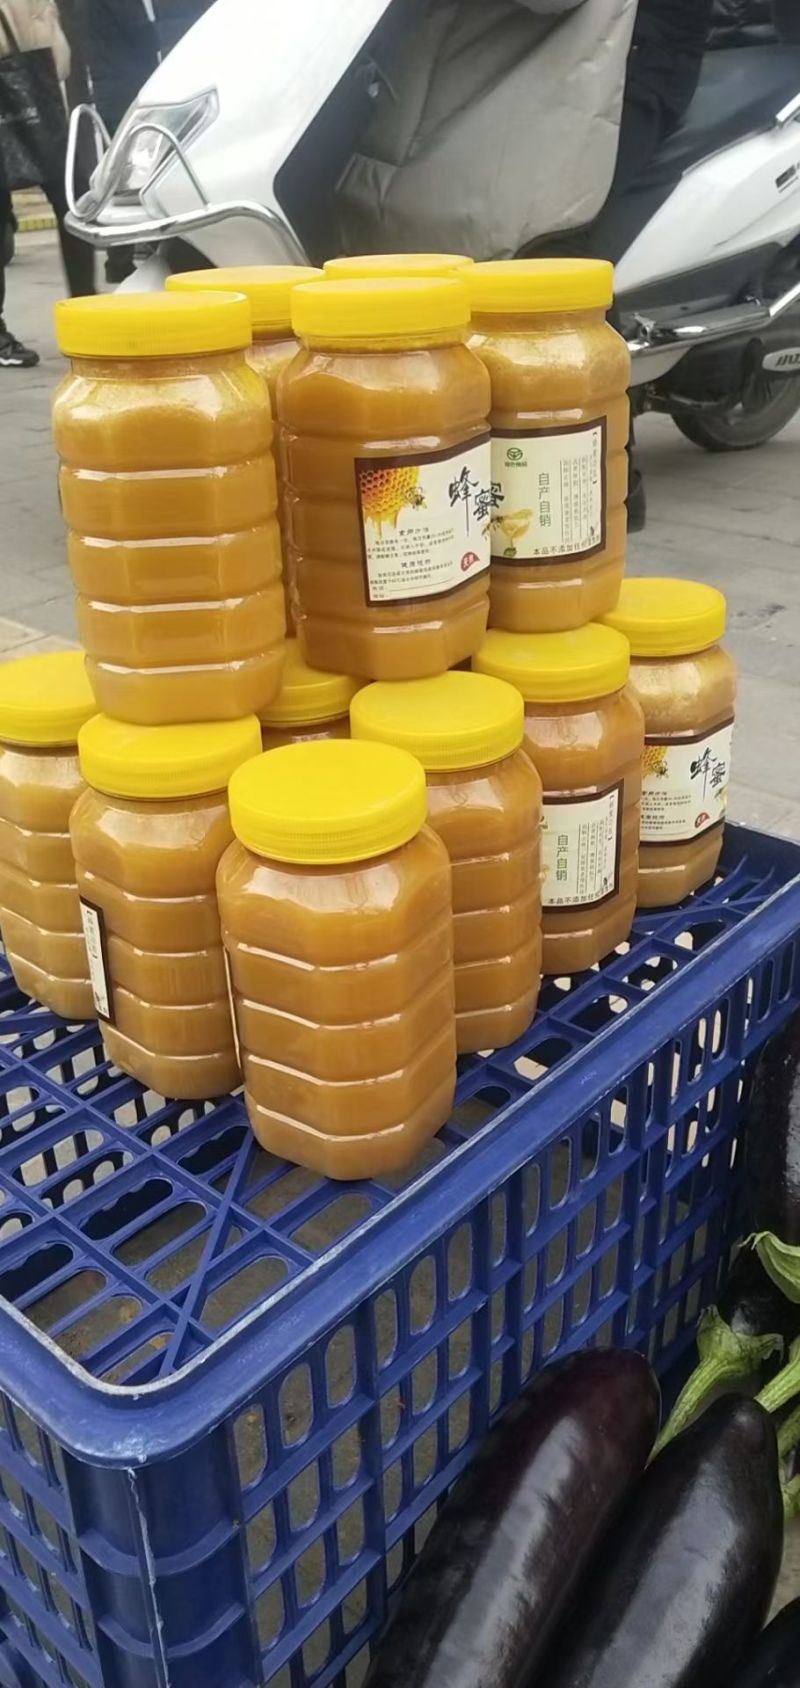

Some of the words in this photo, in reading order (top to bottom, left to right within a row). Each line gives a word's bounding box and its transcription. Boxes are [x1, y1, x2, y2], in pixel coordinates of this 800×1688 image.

[538, 472, 551, 528] 自产自销
[556, 834, 569, 881] 自产自销
